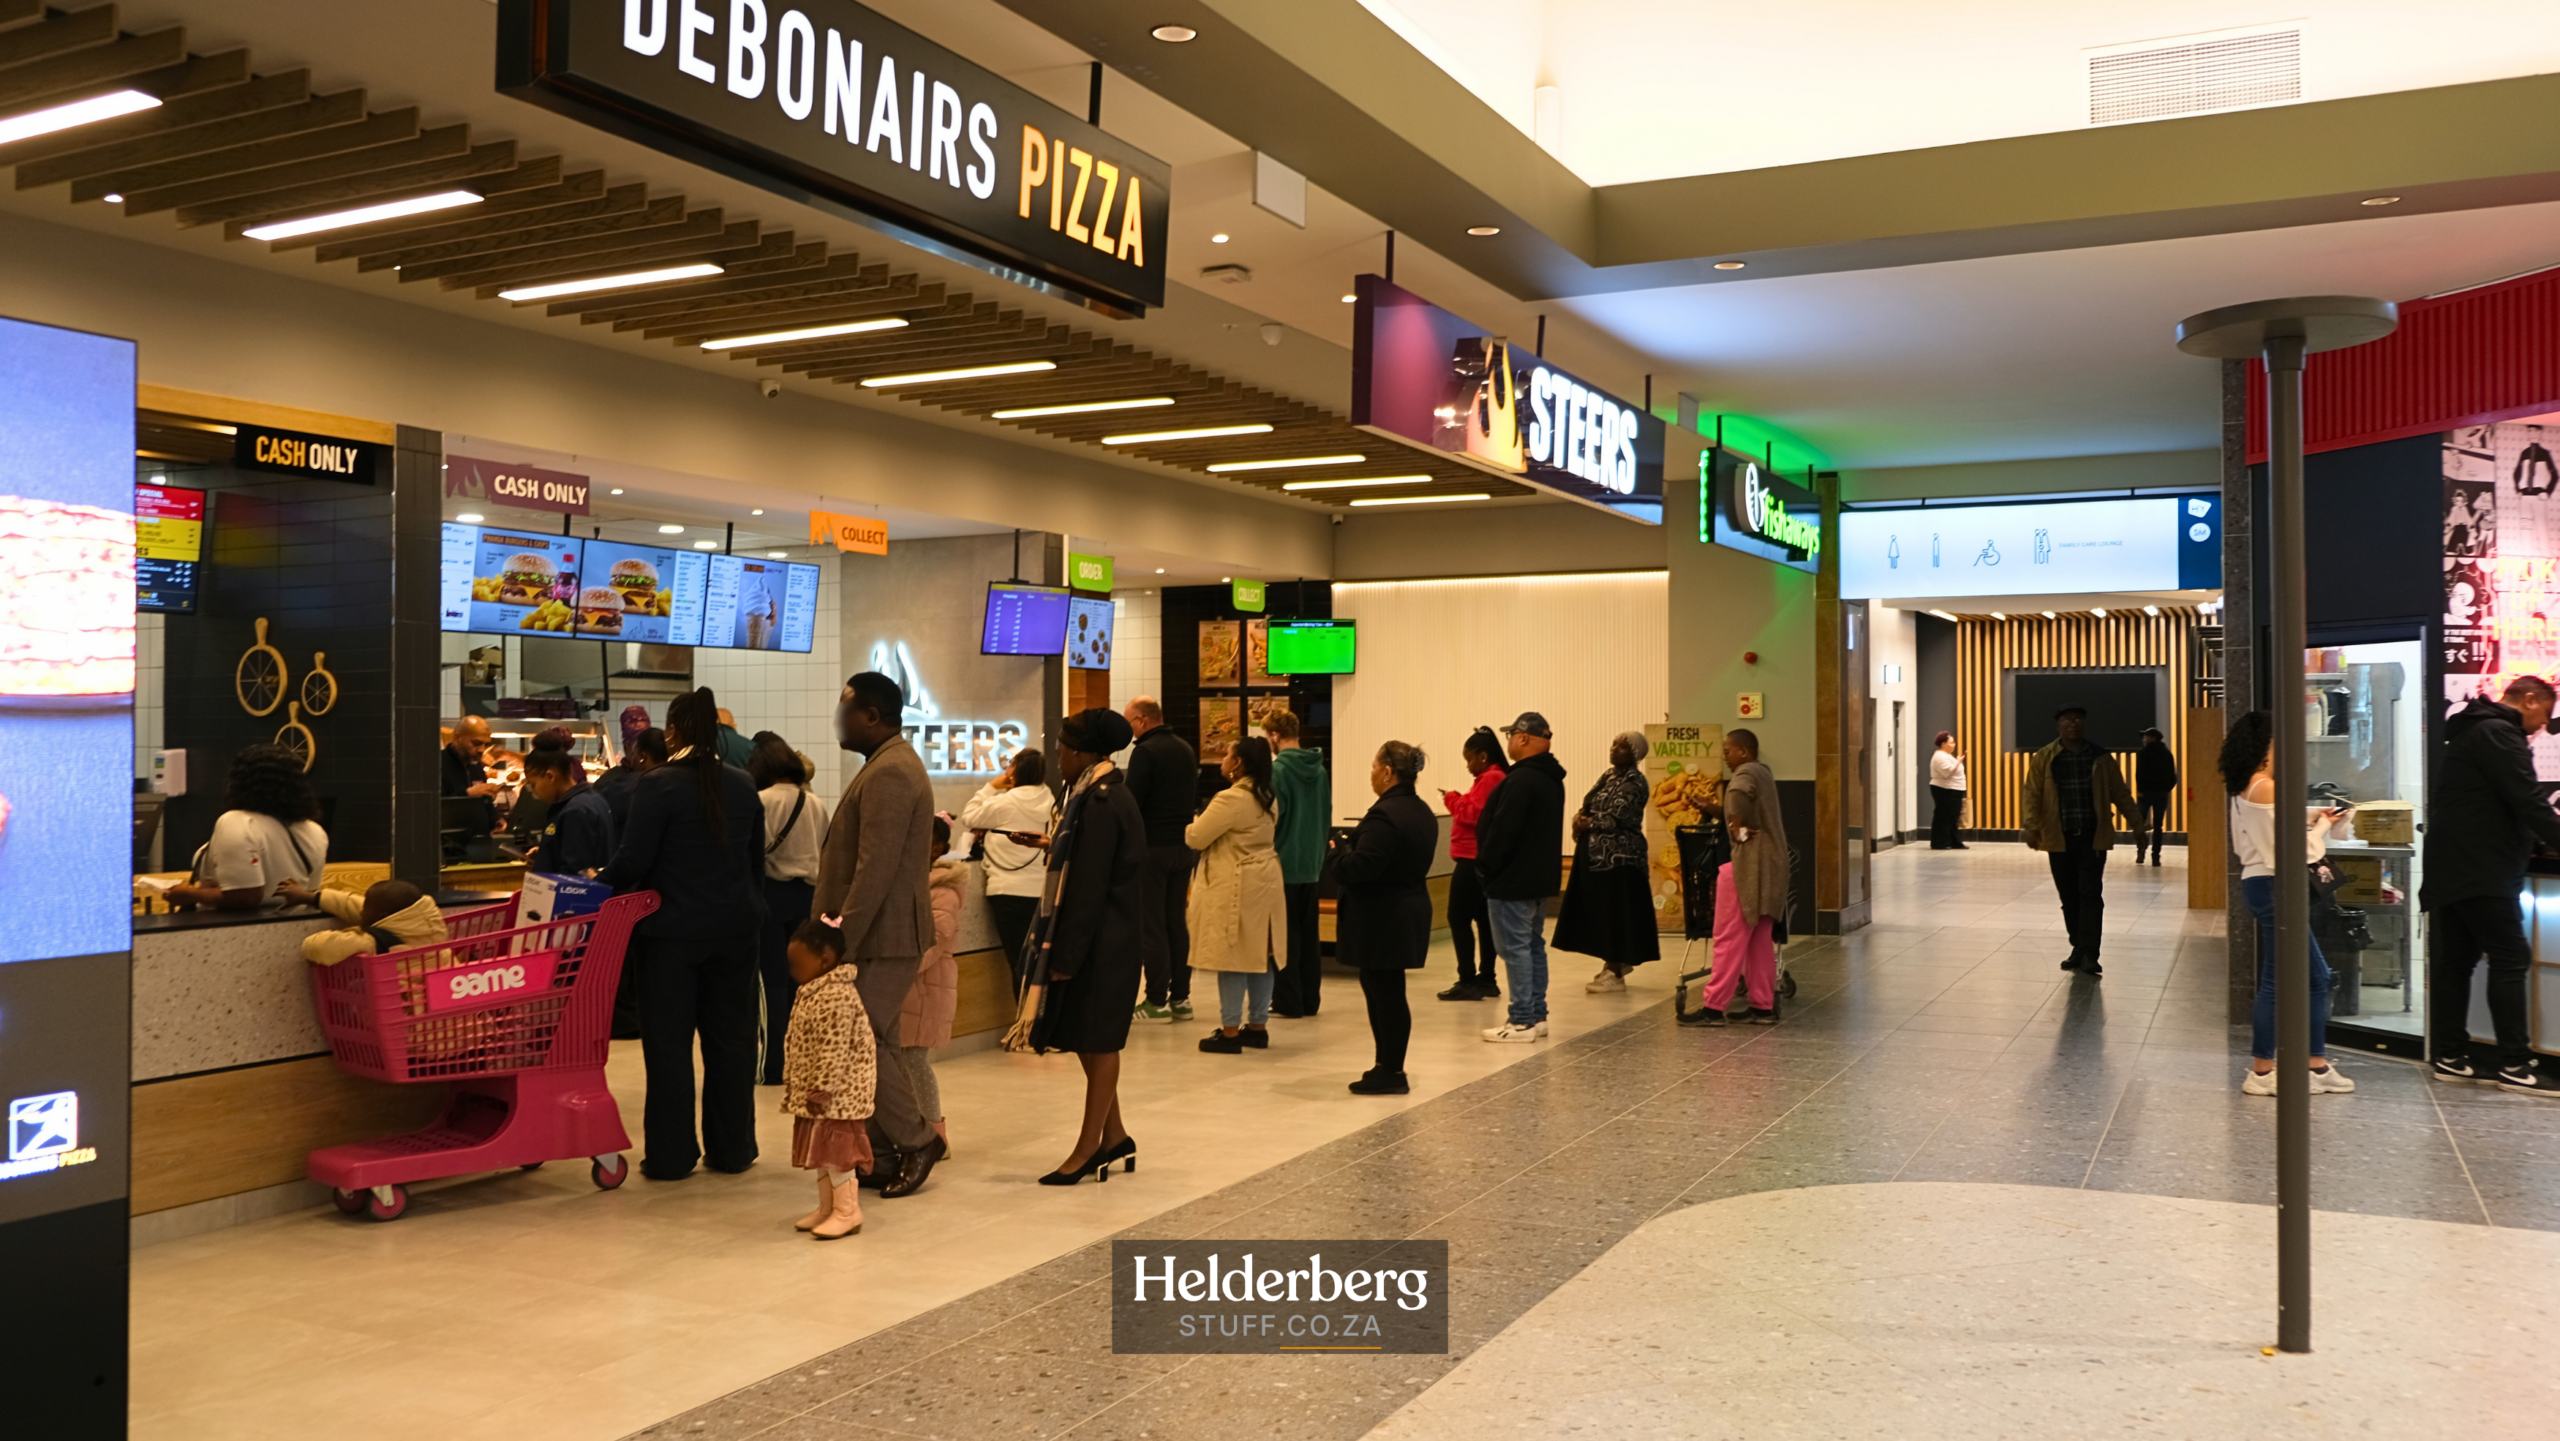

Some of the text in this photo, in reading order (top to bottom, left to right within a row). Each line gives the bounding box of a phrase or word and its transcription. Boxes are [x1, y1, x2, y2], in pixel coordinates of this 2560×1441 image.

[1018, 124, 1145, 268] PIZZA
[1528, 365, 1638, 496] STEERS
[255, 435, 358, 475] CASH ONLY
[494, 474, 588, 506] CASH ONLY
[841, 526, 886, 546] COLLECT
[1763, 494, 1820, 562] fishaways
[1079, 561, 1104, 581] ORDER
[2496, 557, 2558, 583] PICK
[1238, 587, 1261, 604] COLLECT
[2510, 587, 2545, 612] UP
[2493, 616, 2560, 641] HERE
[1666, 727, 1700, 741] FRESH
[902, 721, 1028, 774] TEERS
[1652, 741, 1714, 758] VARIETY
[560, 886, 588, 896] LOGIK
[450, 964, 526, 1000] game
